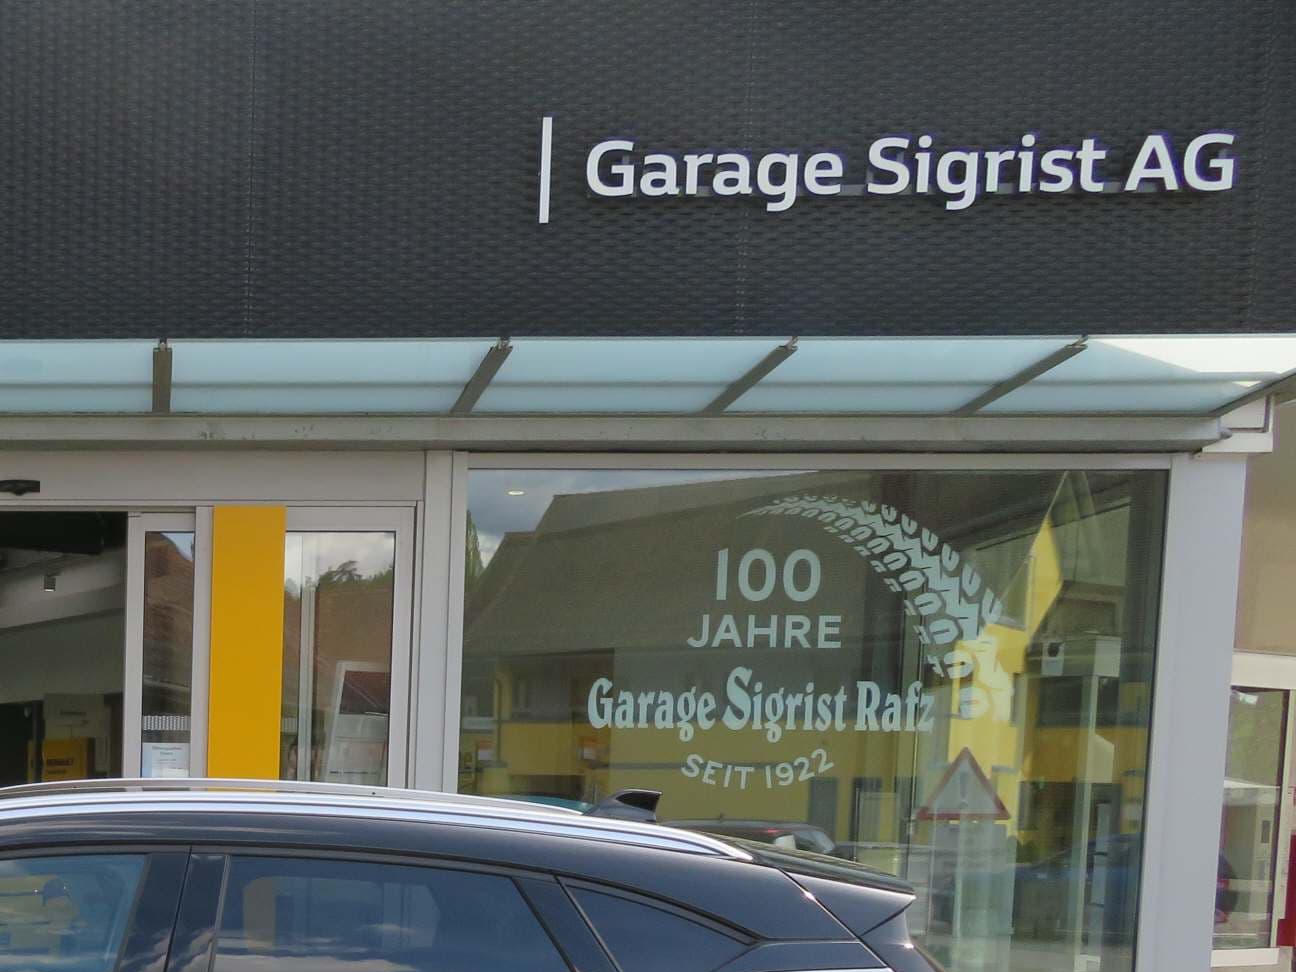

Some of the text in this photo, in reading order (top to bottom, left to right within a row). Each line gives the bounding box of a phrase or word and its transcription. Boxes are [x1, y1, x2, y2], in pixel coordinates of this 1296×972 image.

[587, 133, 1235, 212] Garage Sigrist AG
[716, 548, 821, 602] 100
[687, 614, 842, 649] JAHRE
[588, 666, 935, 743] Garage Sigrist Rafz
[681, 748, 834, 790] SEIT 1922
